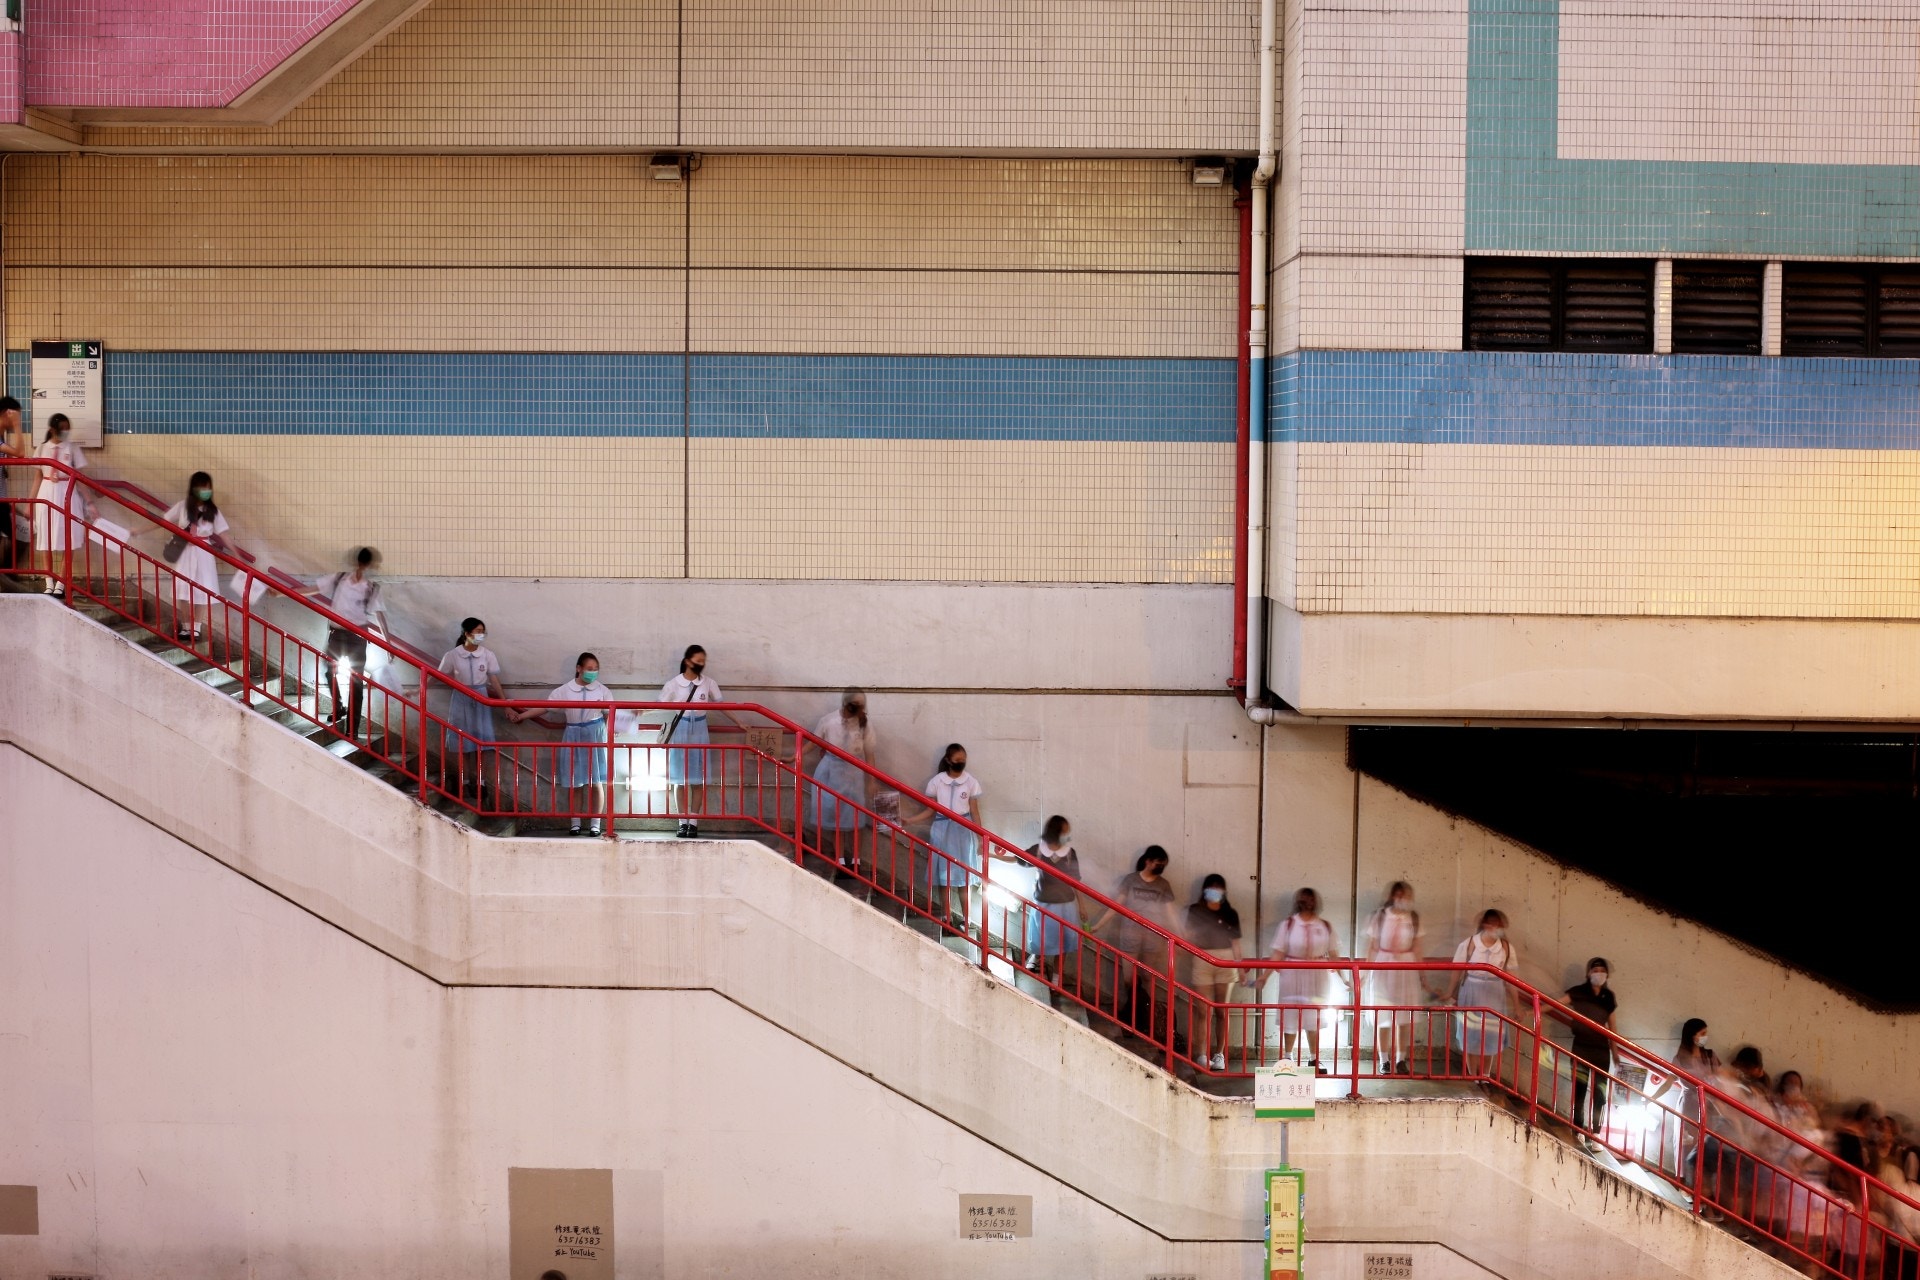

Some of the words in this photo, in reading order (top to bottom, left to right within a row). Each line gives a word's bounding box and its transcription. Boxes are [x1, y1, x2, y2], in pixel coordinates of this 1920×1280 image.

[72, 344, 81, 352] 出
[972, 1218, 1017, 1228] 63516383
[558, 1235, 601, 1246] 63516383
[985, 1232, 1014, 1241] YouTube
[570, 1248, 596, 1258] YouTube
[1367, 1267, 1410, 1277] 63516383
